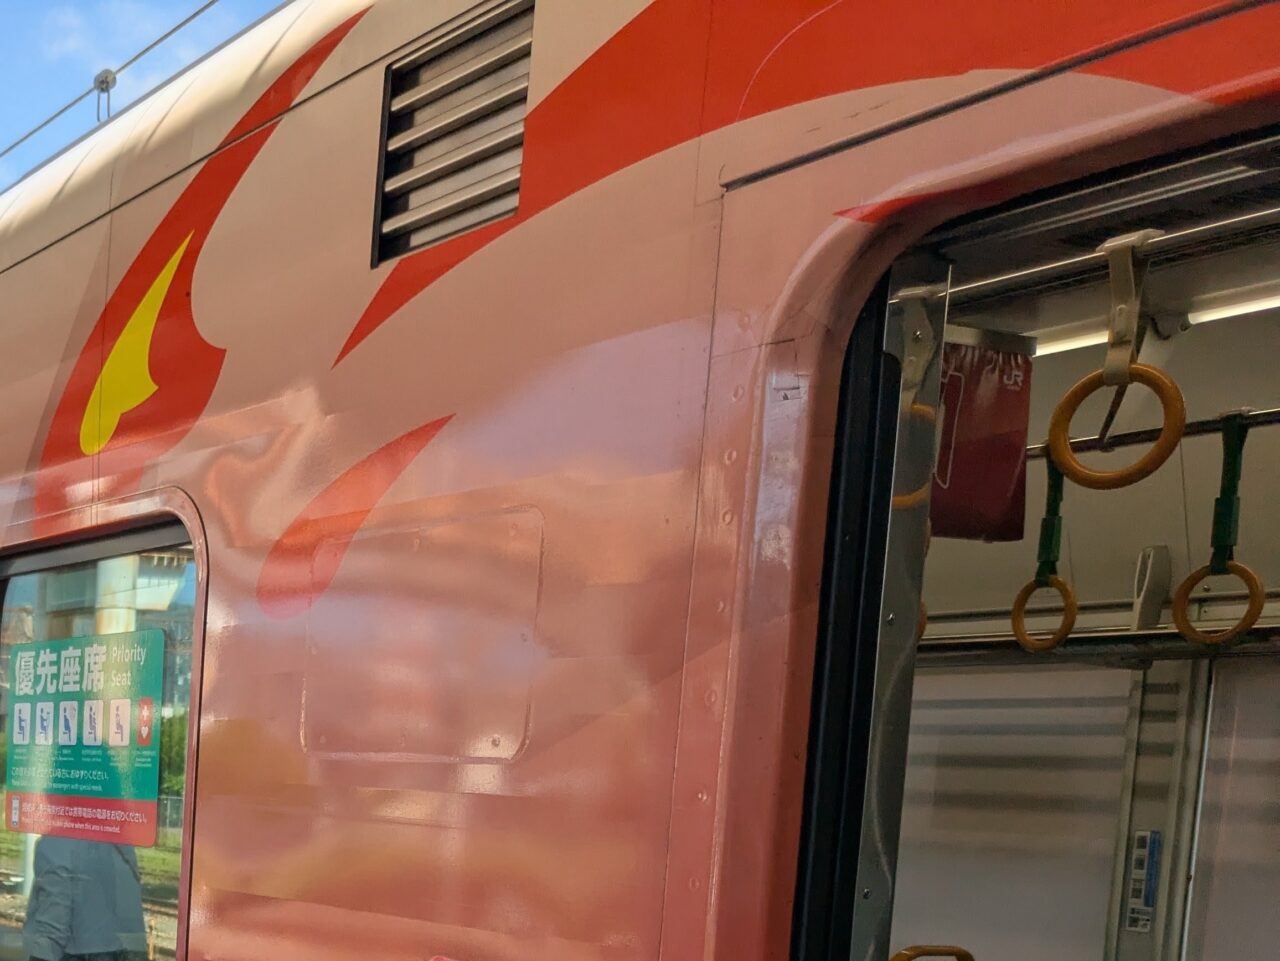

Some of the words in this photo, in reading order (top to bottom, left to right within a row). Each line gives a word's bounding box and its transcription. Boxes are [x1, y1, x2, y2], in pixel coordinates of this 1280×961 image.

[111, 643, 147, 665] Priority
[14, 643, 107, 697] 優先座席
[111, 669, 132, 687] Seat
